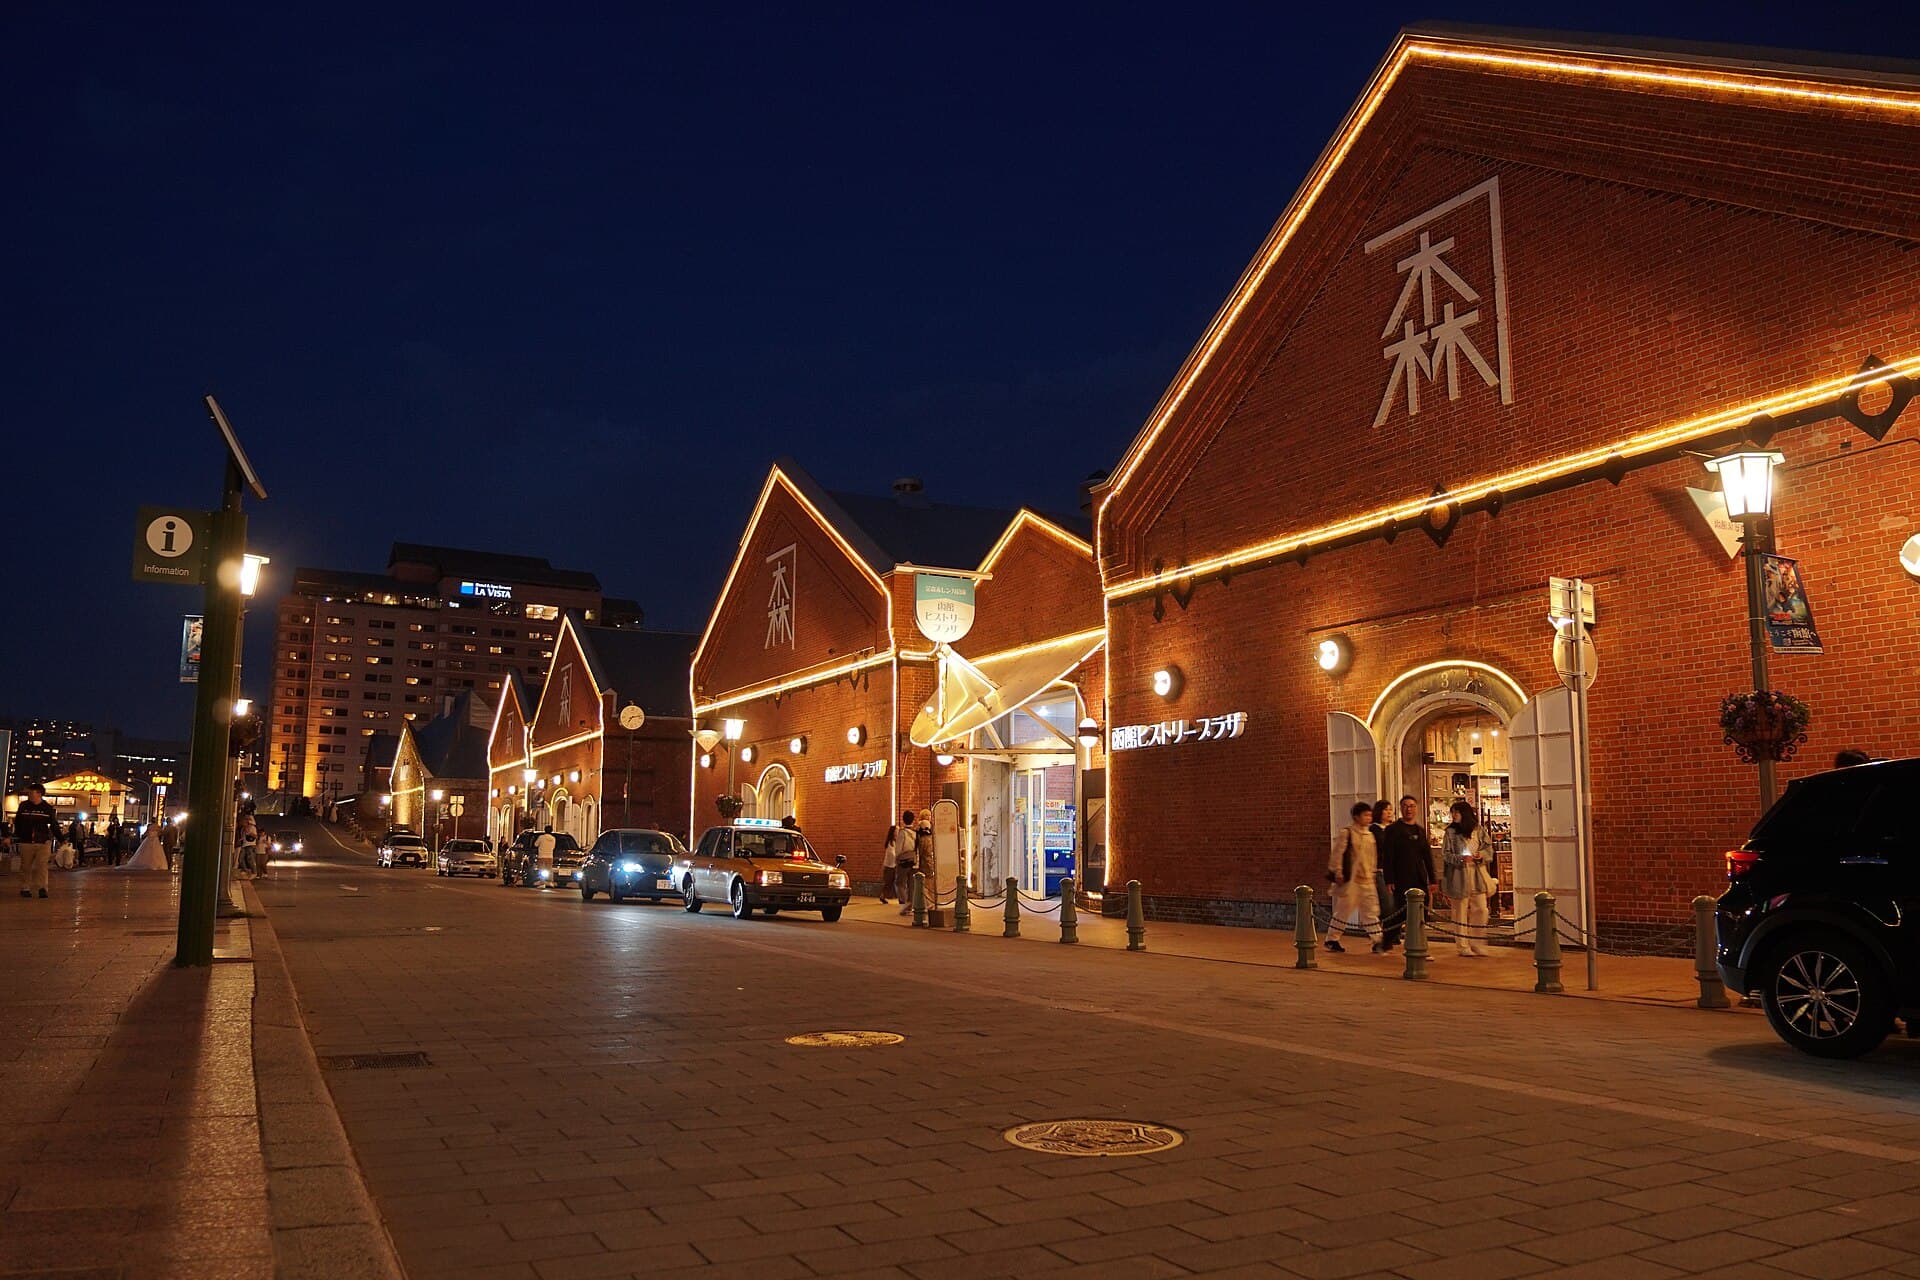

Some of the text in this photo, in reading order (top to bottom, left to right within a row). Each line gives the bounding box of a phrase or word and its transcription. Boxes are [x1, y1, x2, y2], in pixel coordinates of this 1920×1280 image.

[144, 564, 190, 576] Information
[475, 587, 512, 599] LA VISTA
[1111, 711, 1248, 751] 函館ヒストリープラザ
